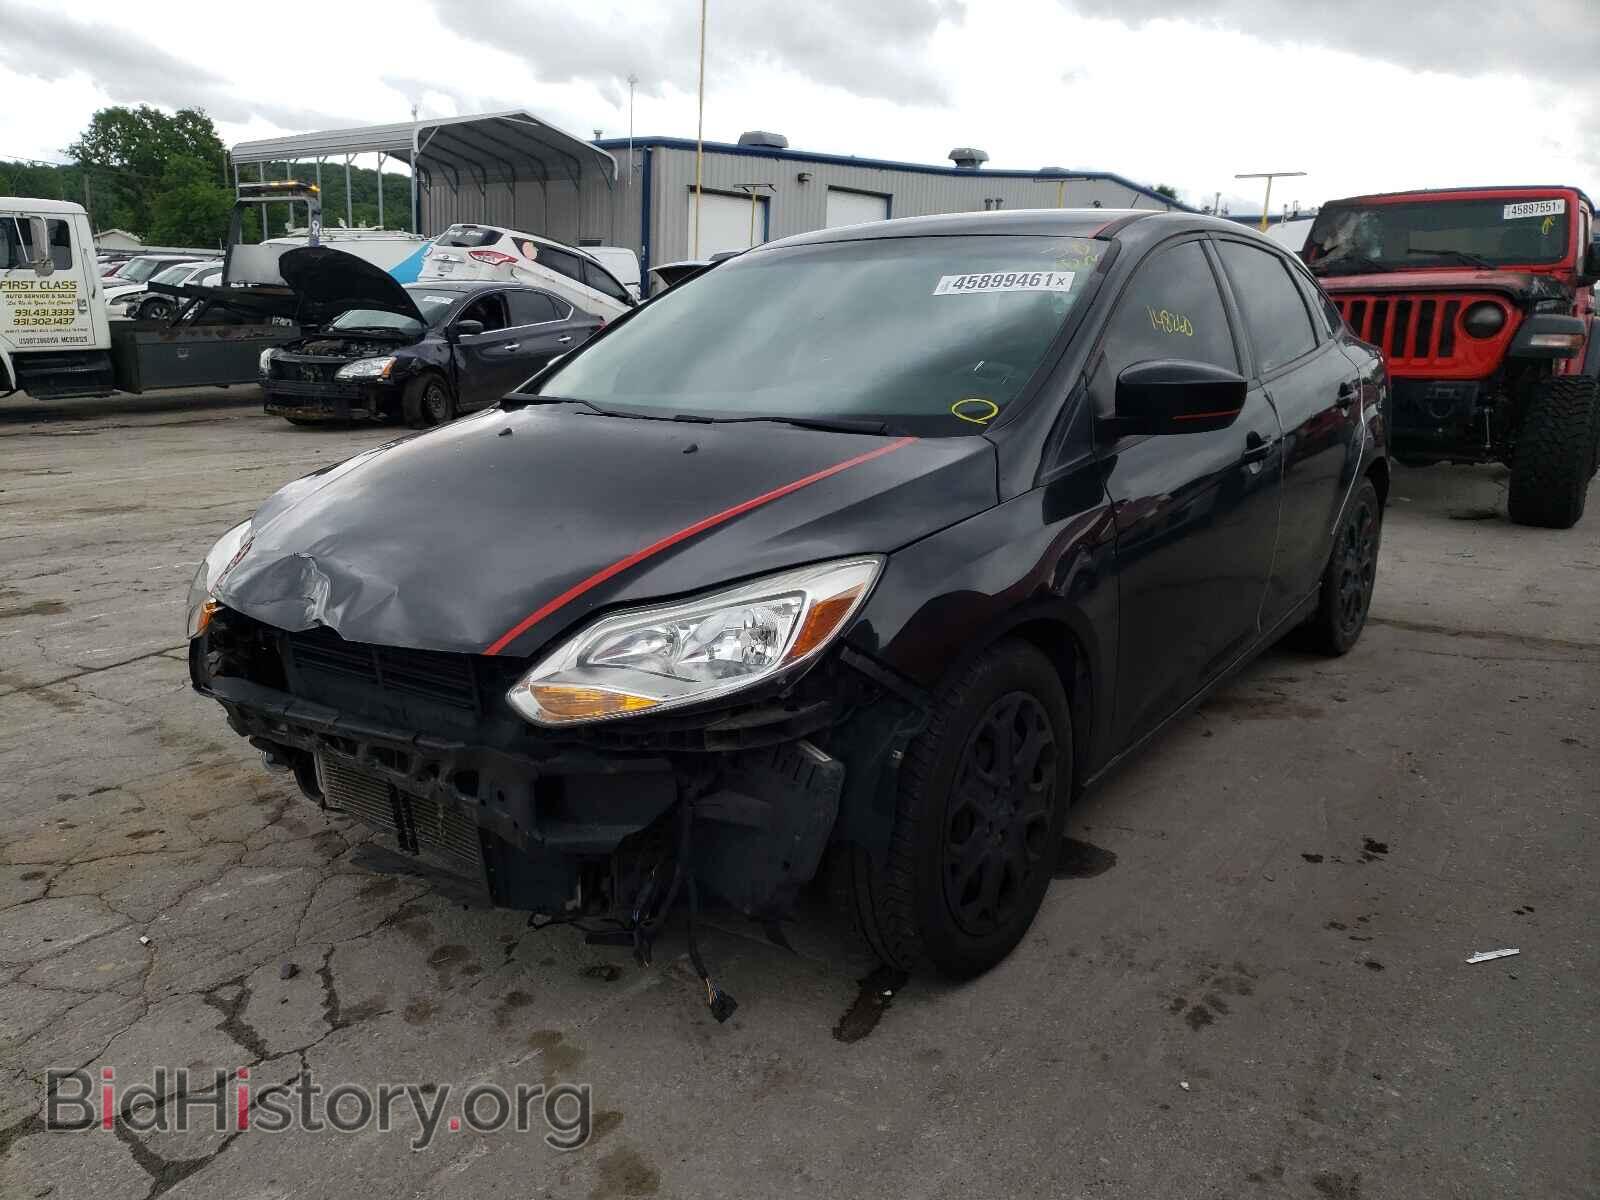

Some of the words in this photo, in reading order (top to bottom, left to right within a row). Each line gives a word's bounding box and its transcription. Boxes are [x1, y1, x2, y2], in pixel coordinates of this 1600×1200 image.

[1511, 202, 1556, 215] 45897551
[40, 280, 77, 290] CLASS
[15, 308, 75, 317] 931.431.3333
[13, 318, 75, 326] 931.302.1437
